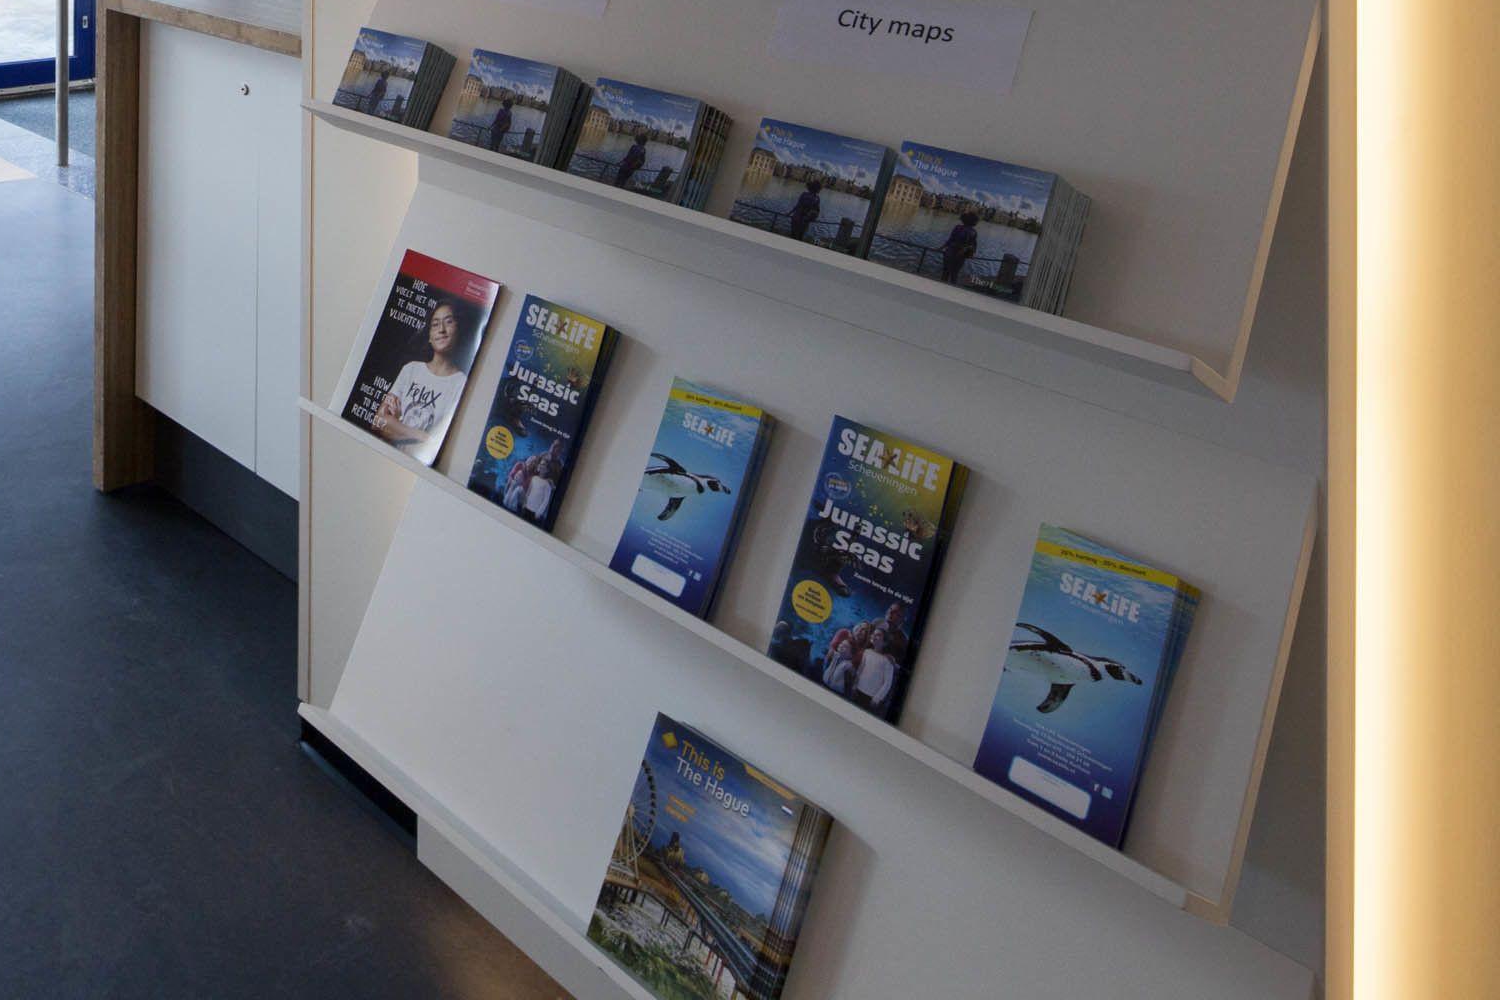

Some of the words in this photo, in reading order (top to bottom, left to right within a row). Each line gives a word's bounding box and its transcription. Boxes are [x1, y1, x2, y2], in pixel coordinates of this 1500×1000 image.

[838, 8, 883, 35] City
[887, 18, 956, 44] maps
[914, 159, 929, 170] The
[930, 163, 959, 178] Hague
[412, 279, 428, 293] HOE
[389, 308, 427, 329] VLUCHTEN?
[397, 298, 405, 308] TE
[526, 303, 559, 335] SEA
[373, 376, 392, 391] HOW
[508, 360, 580, 405] Jurassic
[363, 397, 371, 408] TO
[517, 385, 560, 417] Seas
[683, 412, 708, 435] SEA
[838, 428, 885, 470] SEA
[847, 460, 917, 497] Scheveningen
[818, 499, 924, 561] Jurassic
[832, 530, 895, 575] Seas
[1060, 571, 1098, 604] SEA
[681, 739, 710, 773] This
[711, 760, 726, 781] is
[676, 756, 703, 785] The
[704, 776, 750, 817] Hague
